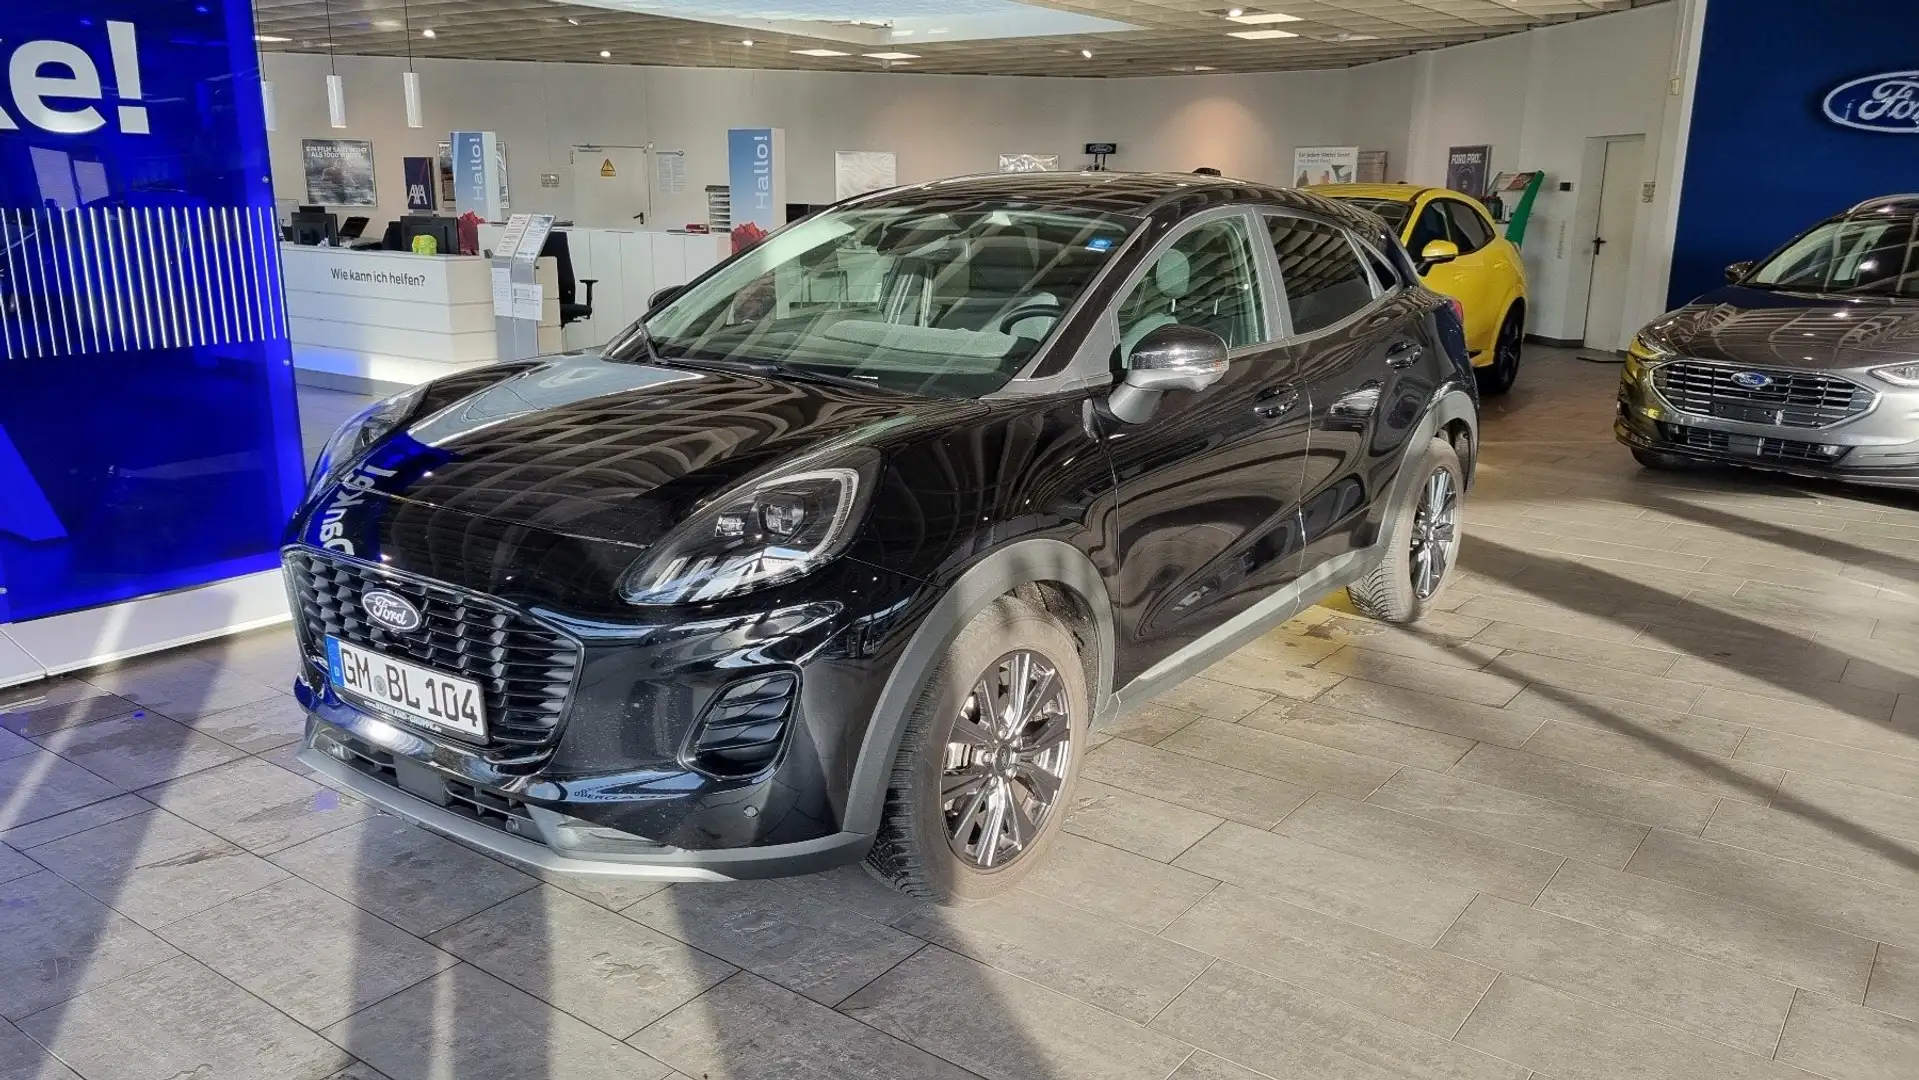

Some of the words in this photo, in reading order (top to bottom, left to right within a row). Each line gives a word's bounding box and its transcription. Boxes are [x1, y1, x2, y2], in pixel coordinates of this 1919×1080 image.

[0, 20, 150, 135] e!
[1858, 80, 1919, 124] Fo
[408, 184, 427, 204] AXA
[469, 137, 484, 201] Hallo!
[754, 136, 768, 209] Hallo!
[330, 267, 348, 281] Wie
[349, 269, 372, 282] kann
[373, 270, 388, 283] ich
[389, 272, 426, 286] helfen?
[373, 597, 408, 626] Ford
[341, 648, 373, 693] GM
[385, 664, 421, 710] BL
[425, 678, 478, 727] 104
